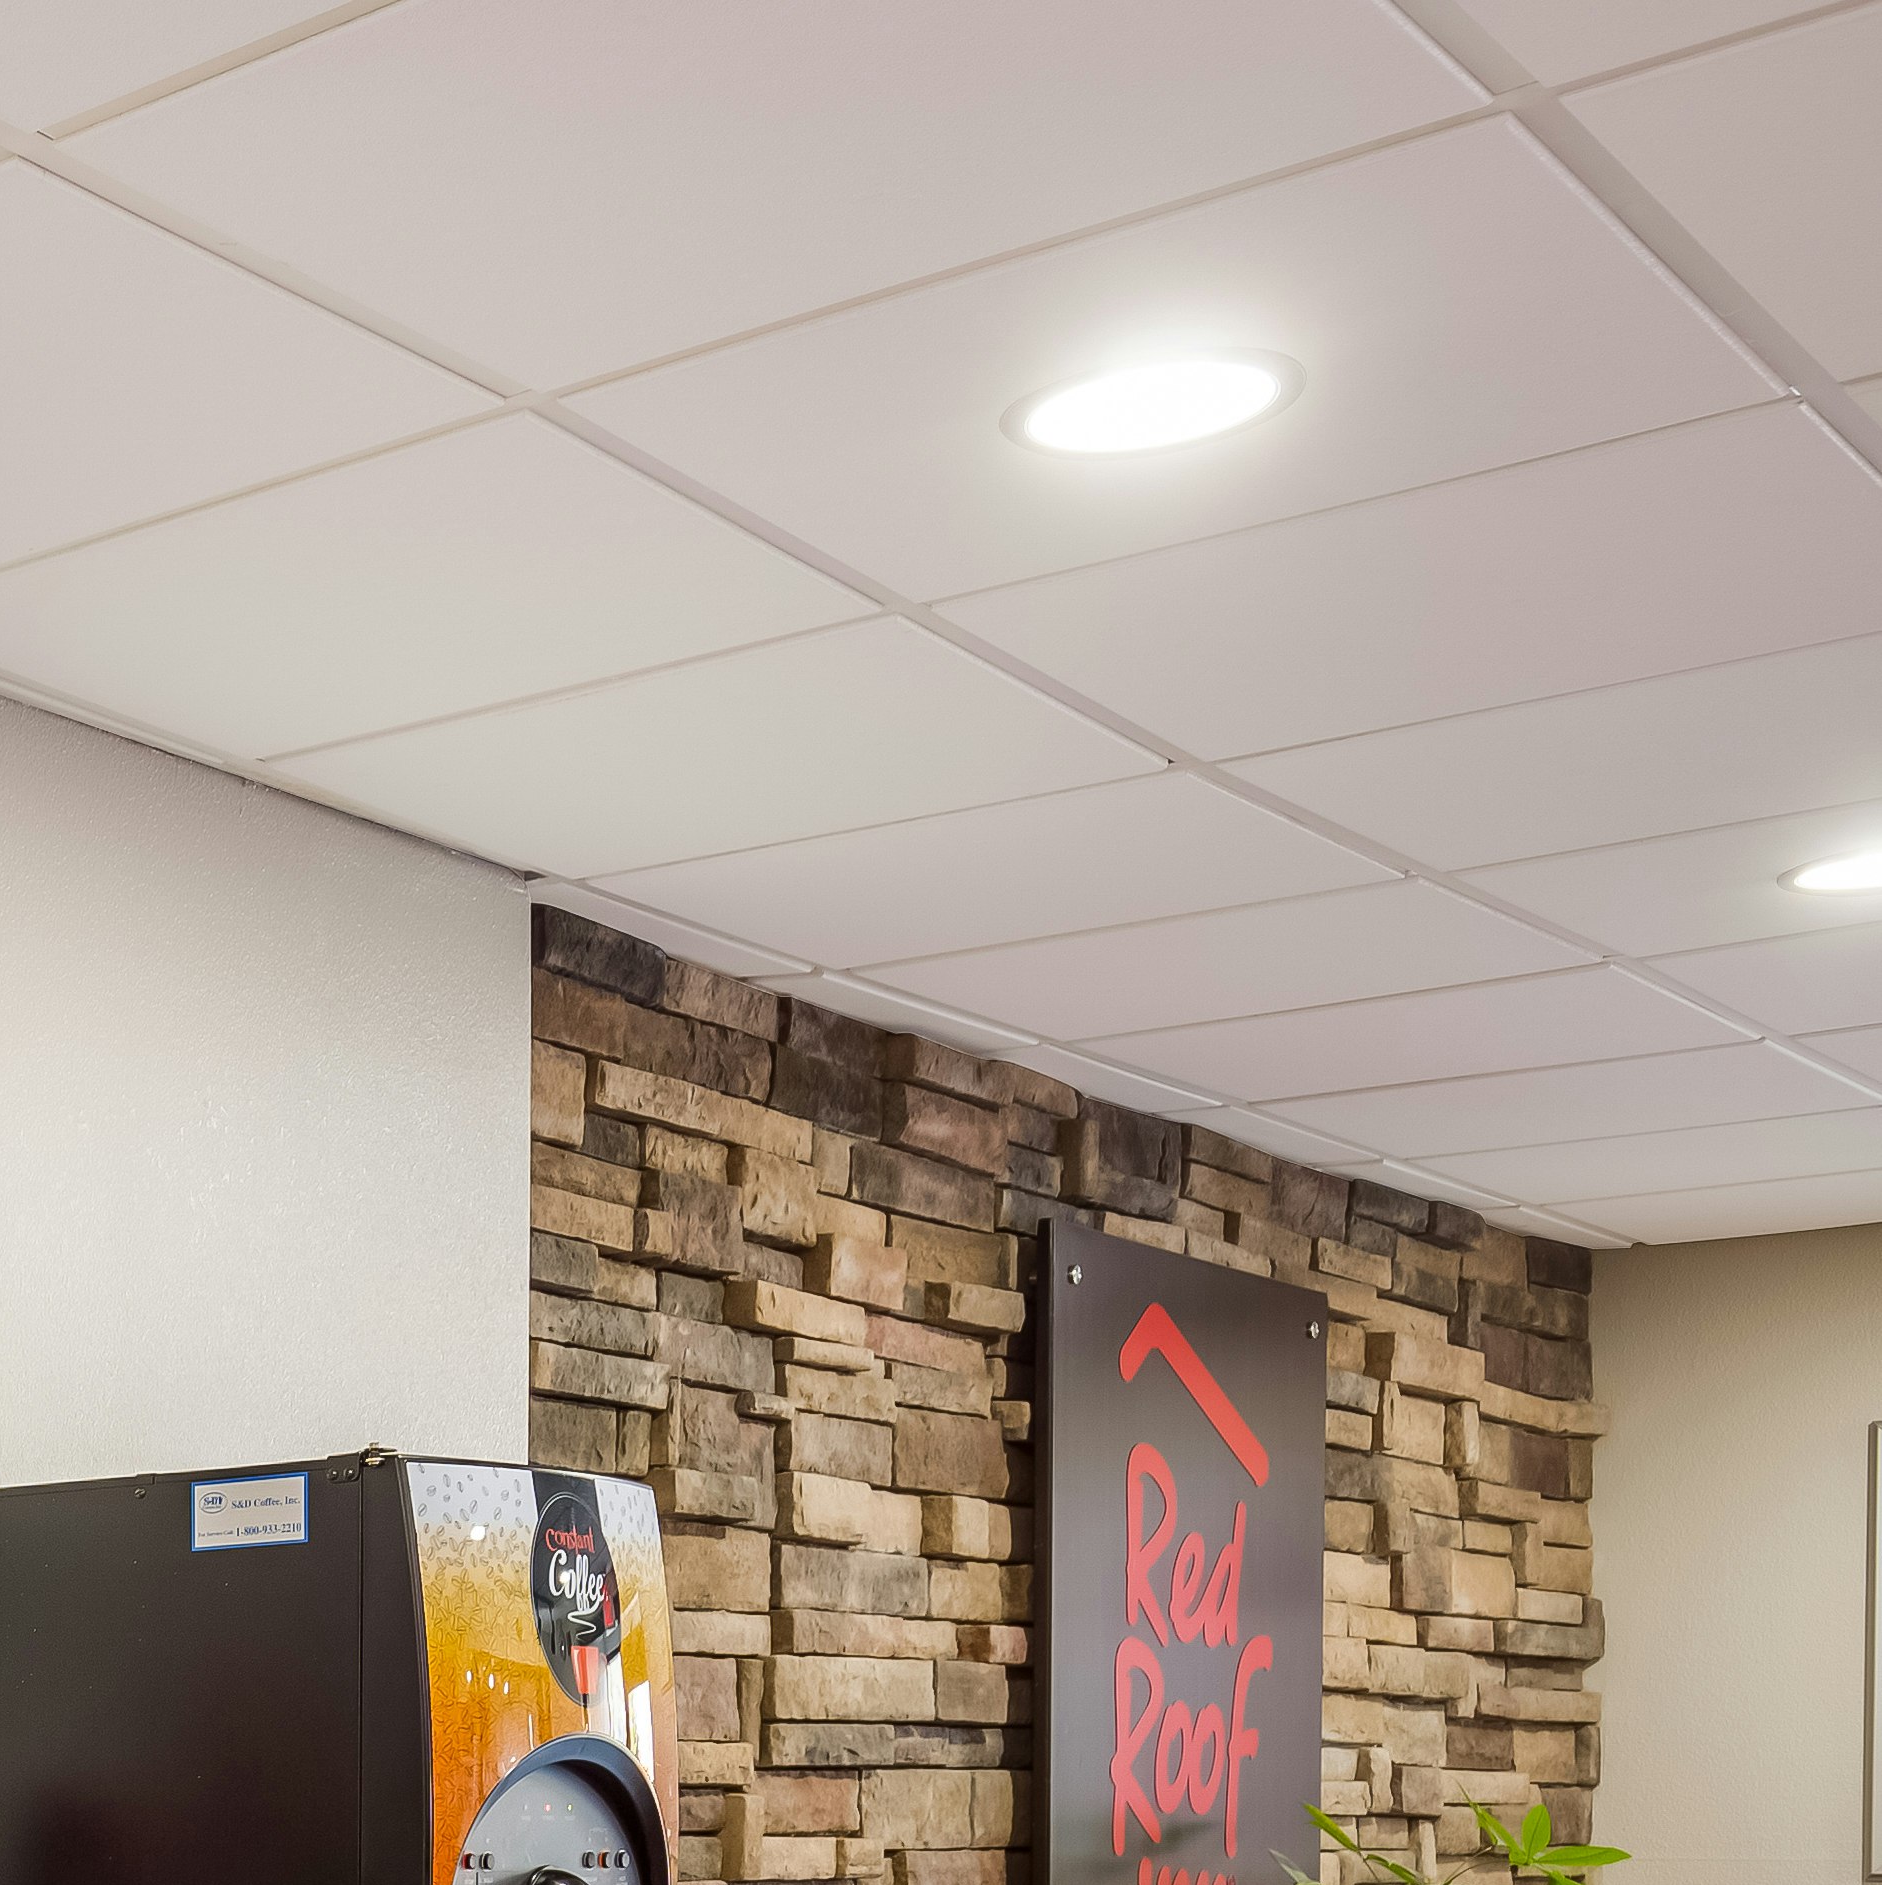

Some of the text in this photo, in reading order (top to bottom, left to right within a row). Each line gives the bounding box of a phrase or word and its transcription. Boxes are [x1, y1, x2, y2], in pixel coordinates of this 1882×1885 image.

[231, 1496, 301, 1509] S&D Coffee, Inc.
[236, 1522, 302, 1537] 1-800-933-2210
[1123, 1441, 1248, 1649] Red
[548, 1549, 606, 1613] Coffee
[1109, 1634, 1274, 1858] Roof
